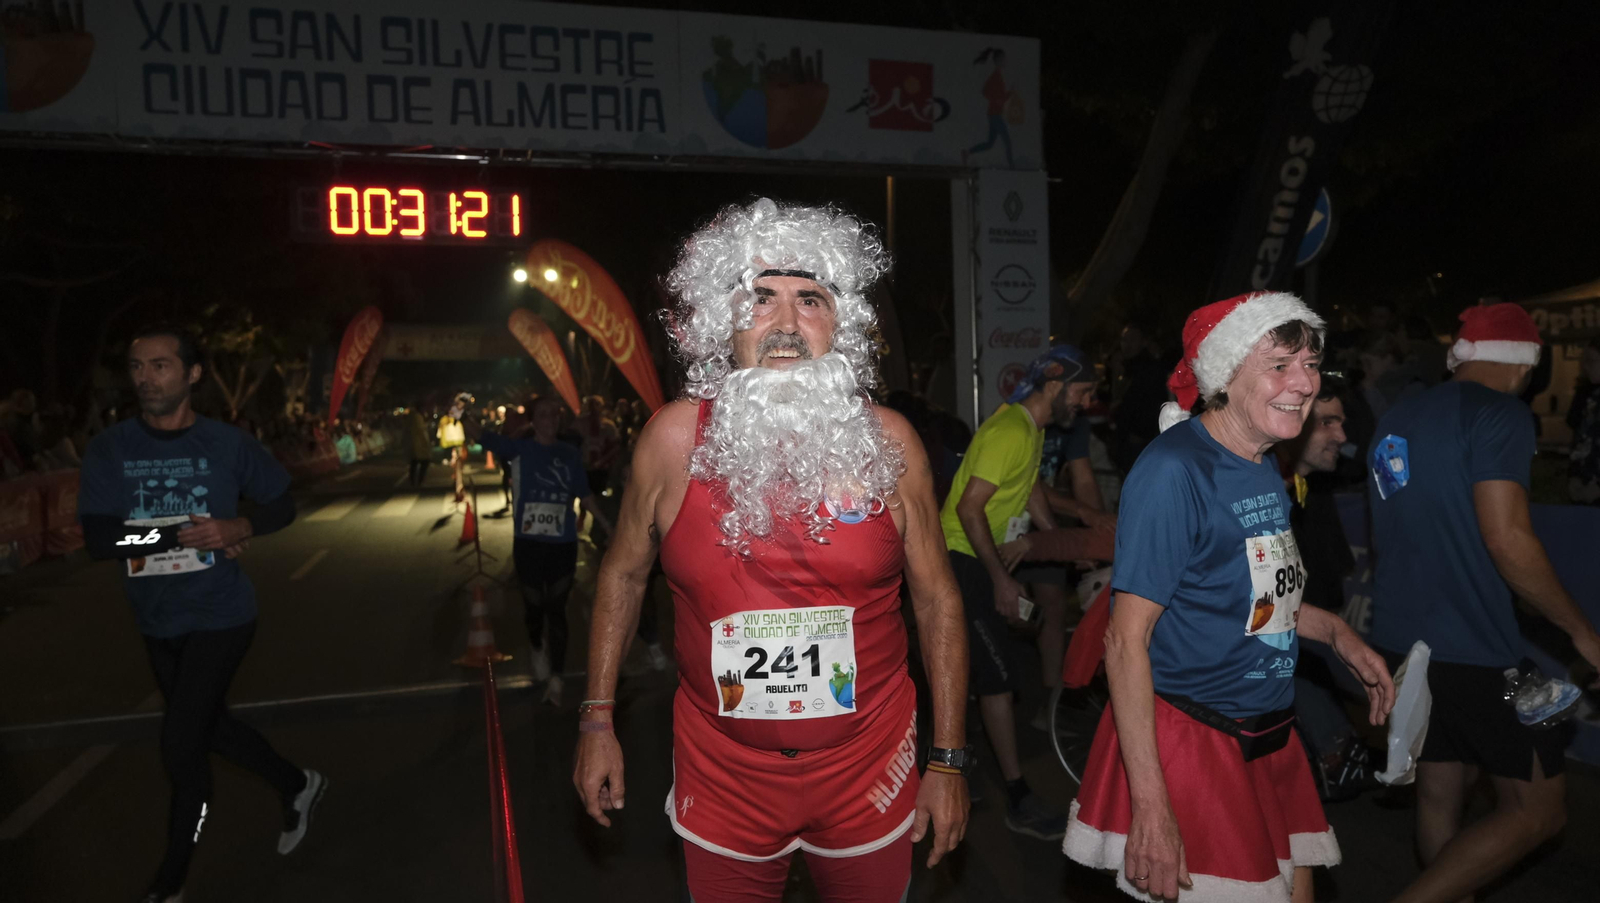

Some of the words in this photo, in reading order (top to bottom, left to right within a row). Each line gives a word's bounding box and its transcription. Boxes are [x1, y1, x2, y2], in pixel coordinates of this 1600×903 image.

[133, 0, 230, 55] XIV
[249, 7, 363, 63] SAN
[380, 16, 656, 78] SILVESTRE
[142, 63, 349, 122] CIUDAD
[366, 74, 434, 125] DE
[450, 77, 667, 133] ALMERÍA
[1275, 561, 1303, 598] 896
[742, 613, 760, 625] XIV
[763, 613, 786, 625] SAN
[788, 609, 846, 624] SILVESTRE
[744, 626, 783, 638] CIUDAD
[786, 625, 800, 637] DE
[744, 644, 821, 679] 241
[765, 683, 808, 694] ABUELITO
